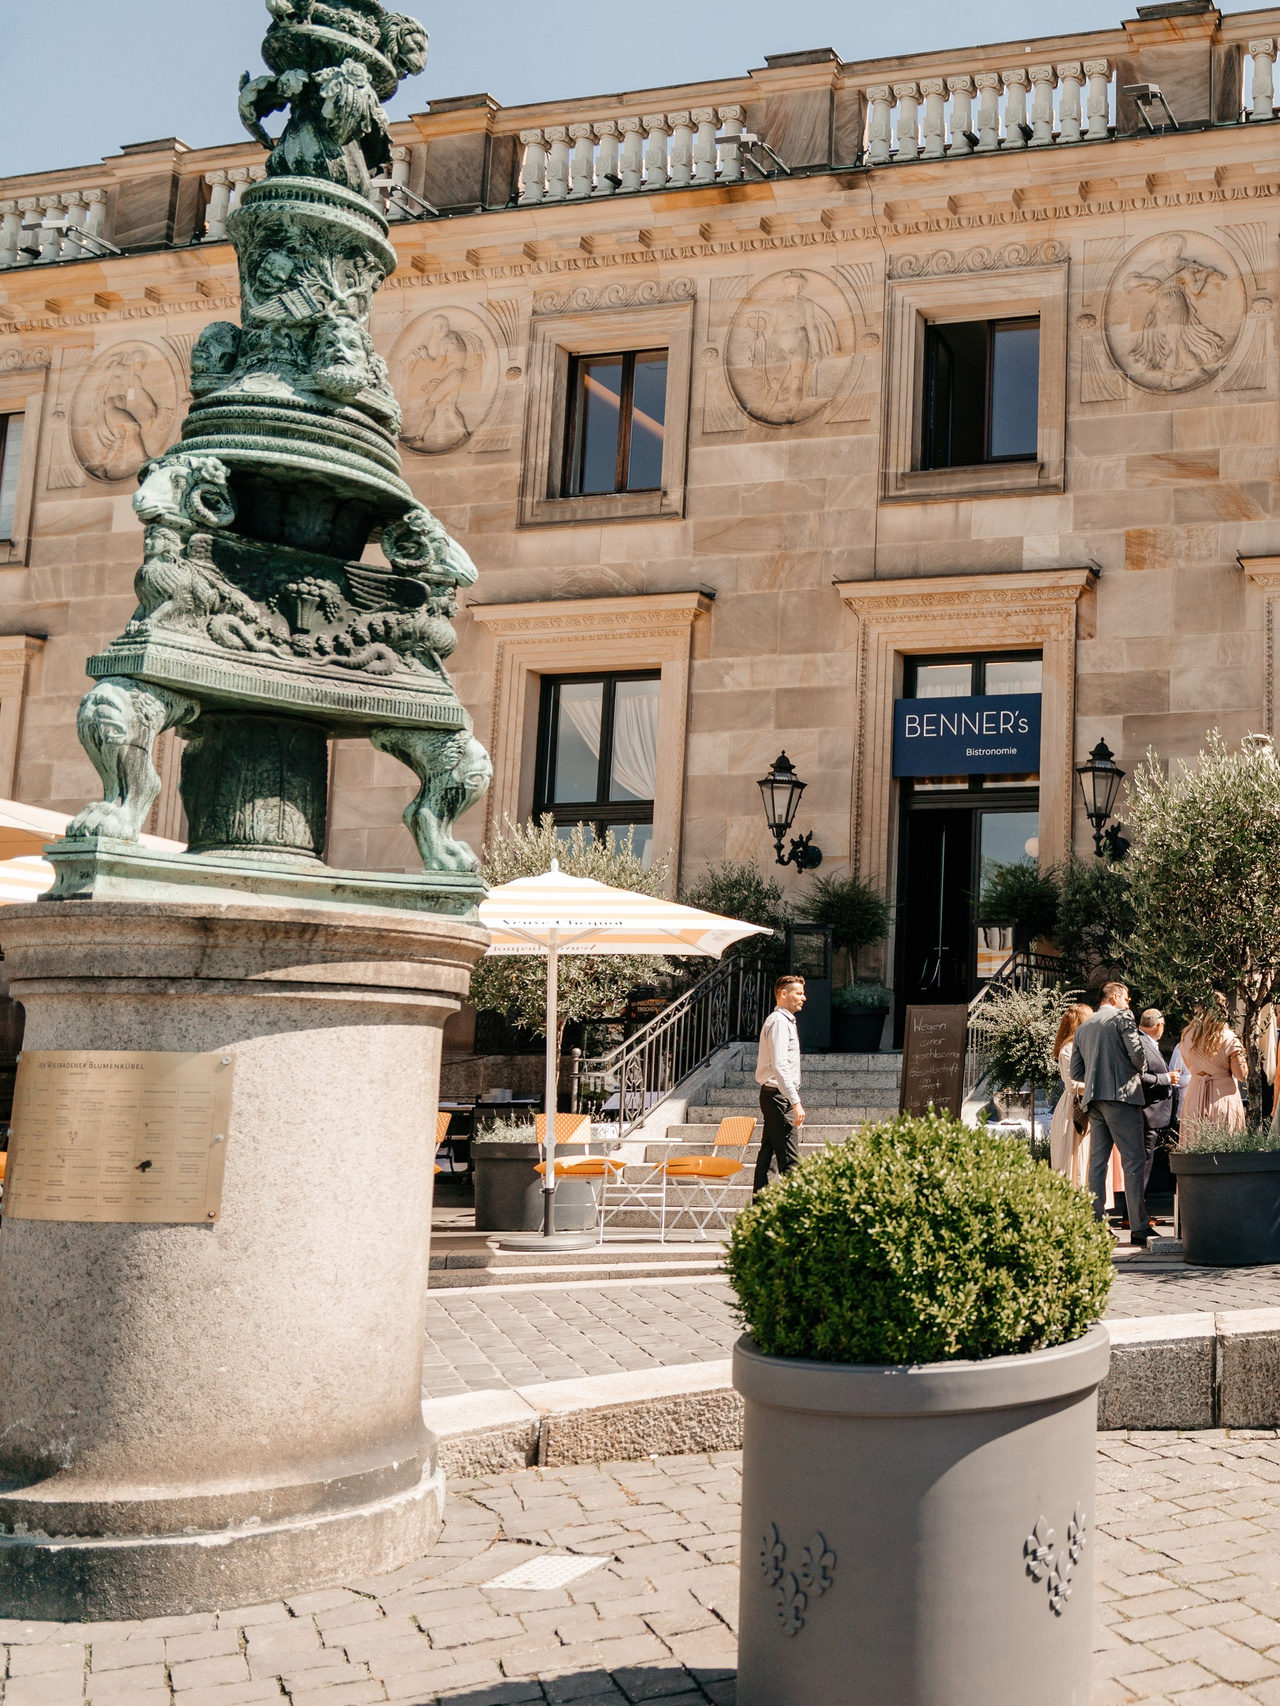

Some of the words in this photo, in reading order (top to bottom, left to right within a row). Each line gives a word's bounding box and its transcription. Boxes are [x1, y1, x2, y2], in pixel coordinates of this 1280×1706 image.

[905, 710, 1029, 738] BENNER's
[965, 746, 1018, 757] Bistronomie
[913, 1017, 947, 1034] Wegen
[919, 1036, 945, 1047] einer
[88, 1061, 145, 1070] BLUMENKÜBEL
